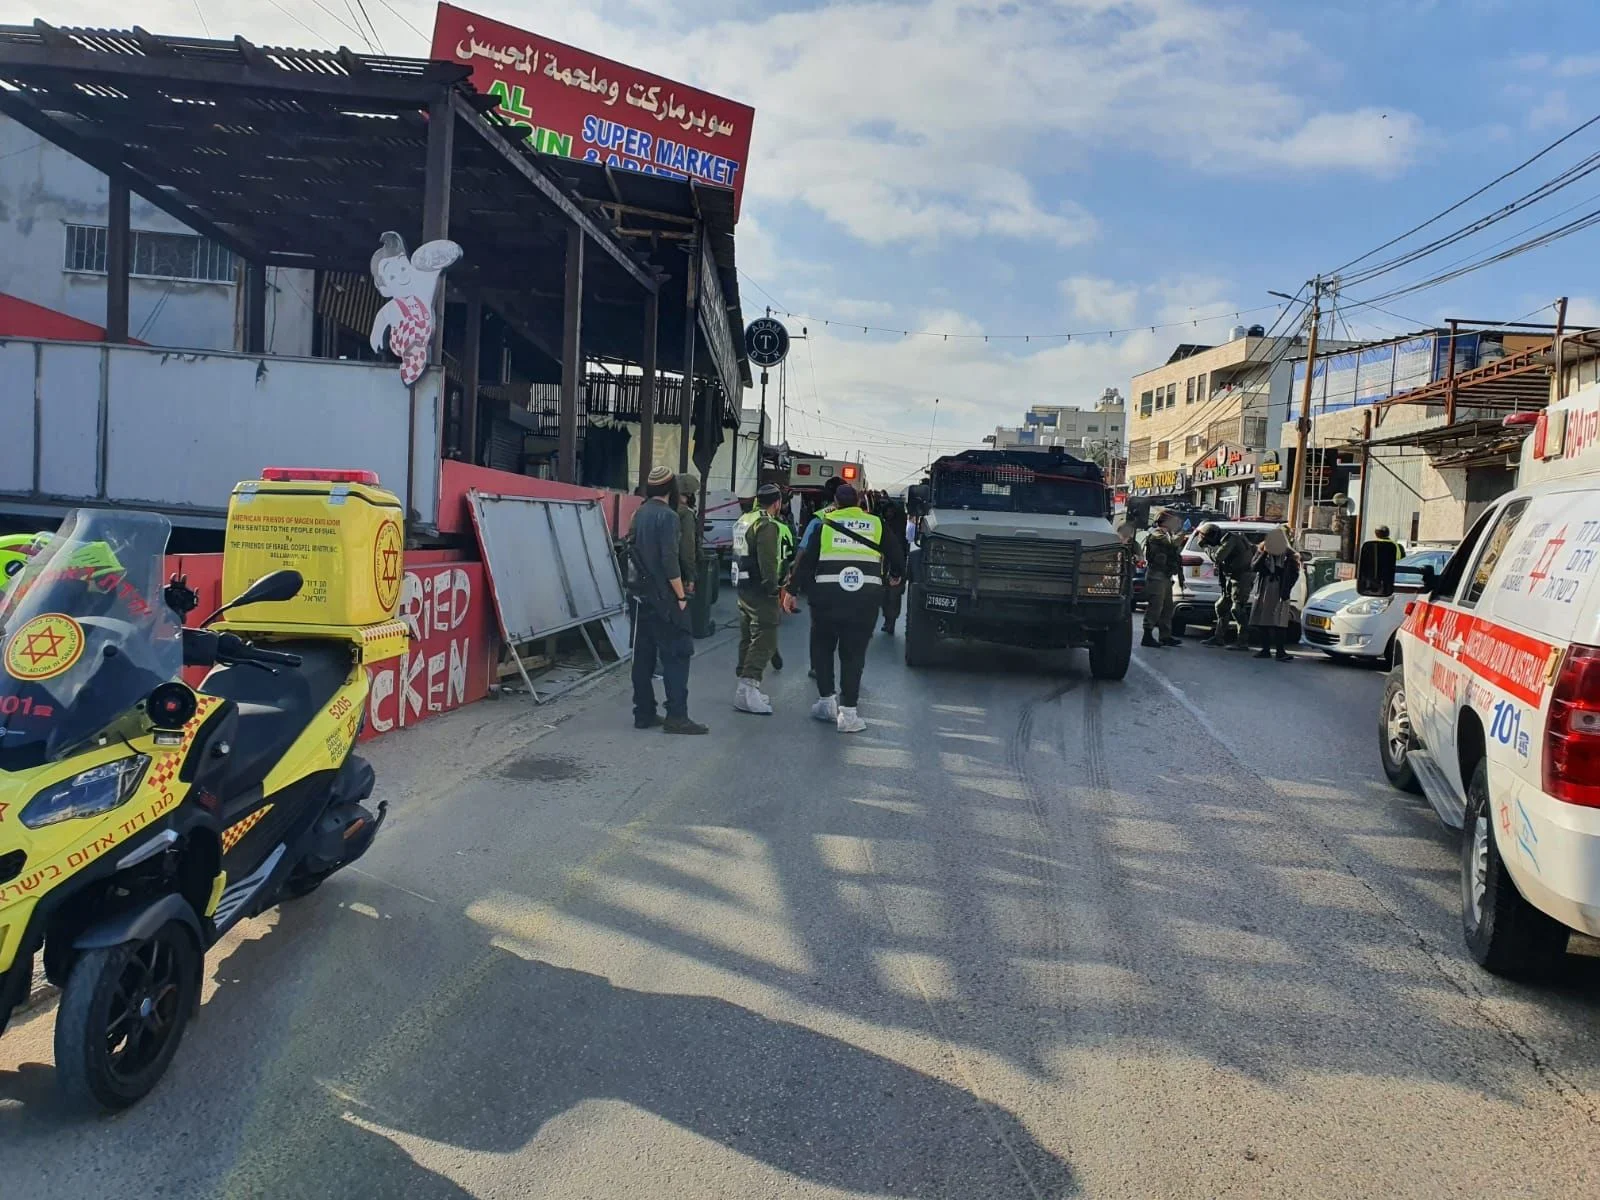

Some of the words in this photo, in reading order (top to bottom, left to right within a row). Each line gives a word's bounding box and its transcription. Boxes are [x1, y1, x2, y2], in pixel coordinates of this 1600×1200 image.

[543, 53, 619, 106] وملحمة
[625, 83, 734, 138] سوبرماركت
[582, 114, 652, 160] SUPER
[655, 137, 740, 186] MARKET
[751, 320, 781, 333] ADAM
[760, 335, 772, 349] T
[233, 524, 270, 532] PRESENTED
[291, 526, 313, 534] PEOPLE
[263, 515, 284, 524] FRIENDS
[242, 542, 264, 550] FRIENDS
[397, 569, 471, 643] RiED
[370, 637, 470, 732] CKEN
[328, 695, 352, 720] 5205
[1490, 700, 1521, 750] 101
[151, 792, 174, 817] מגן
[118, 811, 147, 835] דוד
[67, 833, 116, 868] אדום
[0, 865, 62, 902] בישרא
